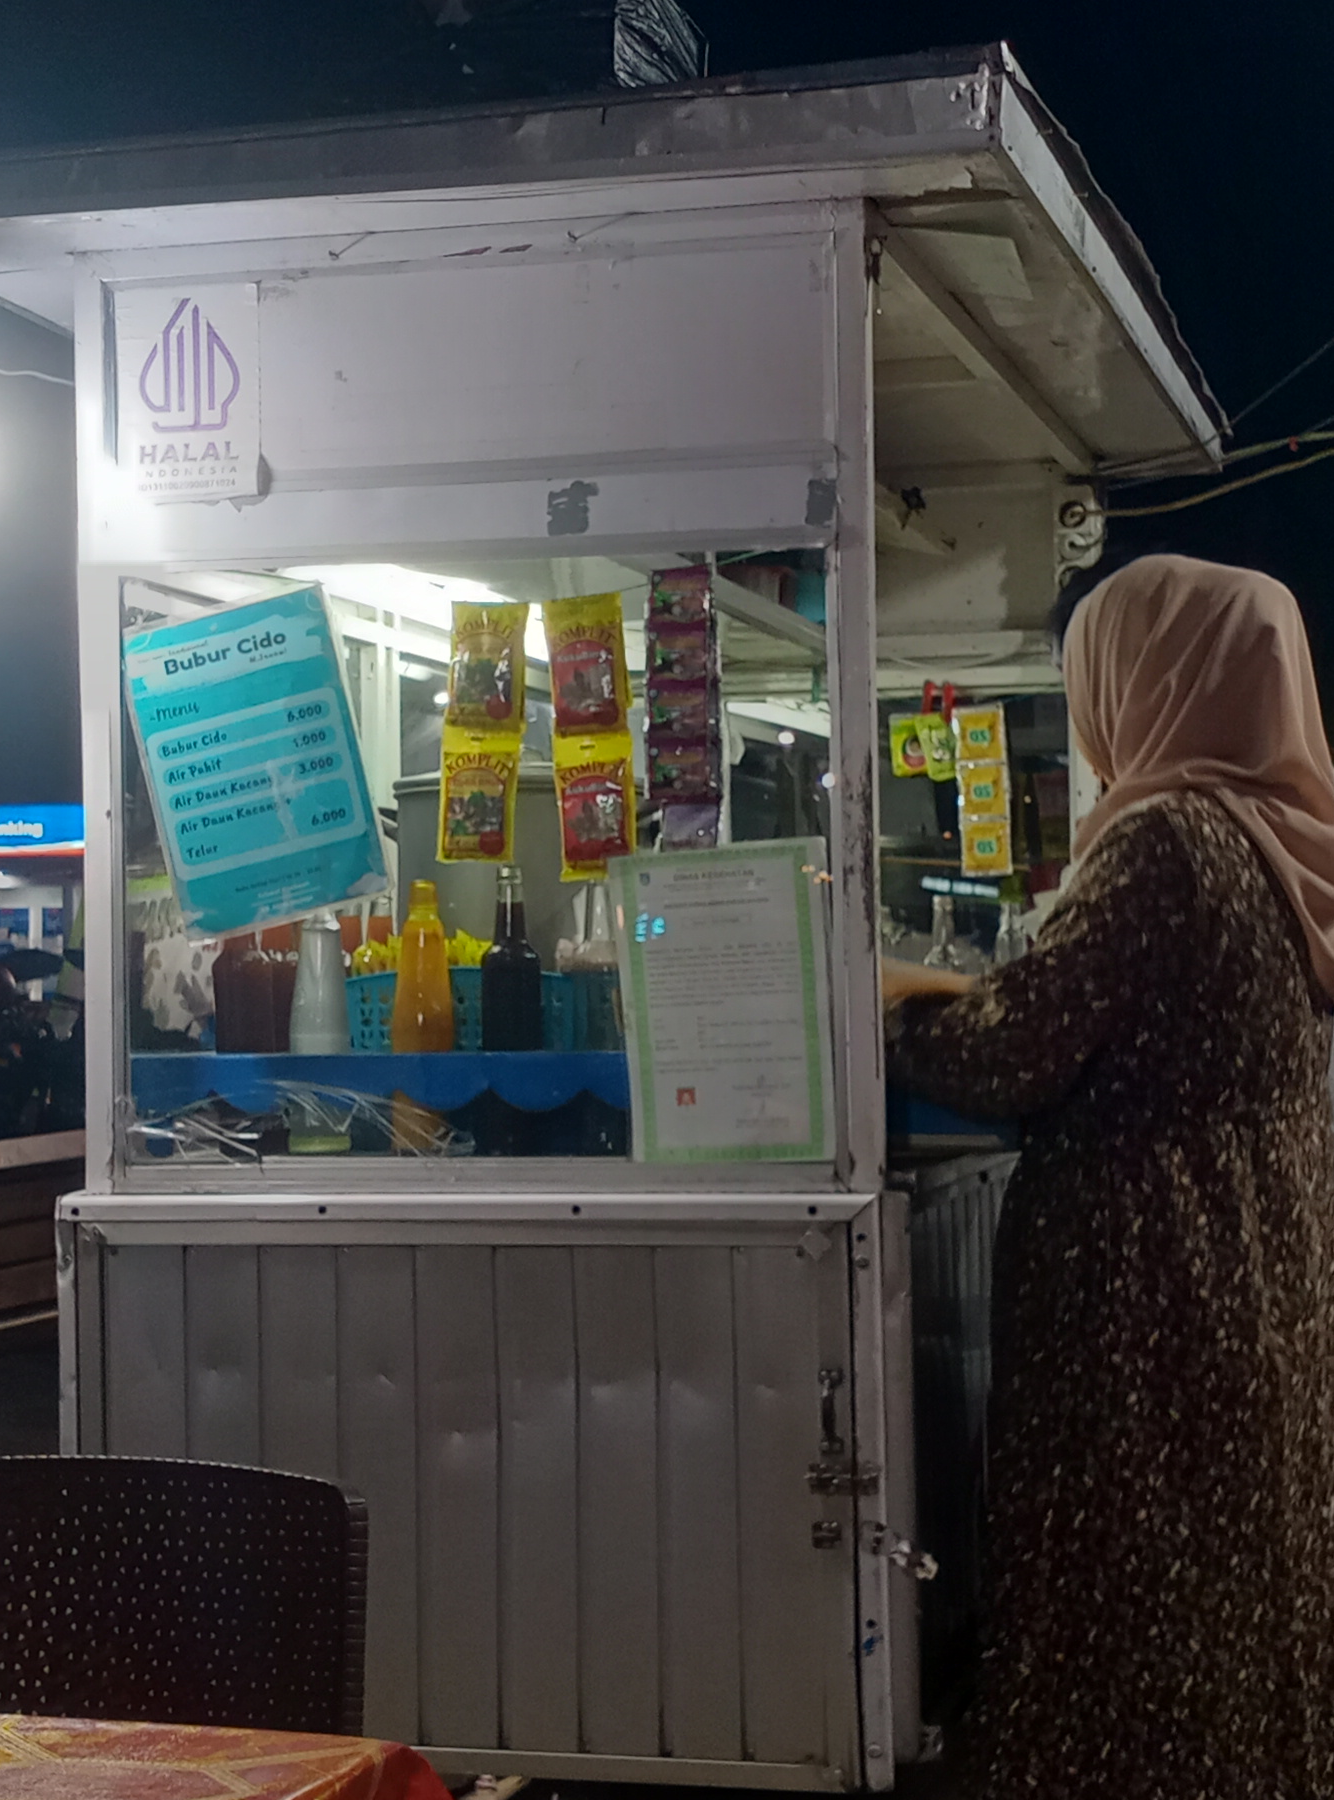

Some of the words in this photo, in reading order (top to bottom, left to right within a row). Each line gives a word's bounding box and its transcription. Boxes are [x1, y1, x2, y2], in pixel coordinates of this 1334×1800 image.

[139, 440, 239, 465] HALAL
[143, 466, 238, 478] NDONESIA
[164, 647, 231, 675] Bubur
[237, 631, 286, 654] Cido
[162, 739, 198, 758] Bubur
[201, 731, 228, 750] Cido
[167, 769, 186, 784] Air
[188, 759, 223, 778] Pahit
[445, 752, 510, 777] KOMPLIT
[560, 759, 625, 785] KOMPL
[174, 795, 193, 810] Air
[196, 787, 227, 805] Daun
[298, 756, 334, 775] 3.000
[180, 820, 199, 835] Air
[201, 812, 234, 830] Daun
[236, 802, 277, 822] Kacan
[186, 844, 219, 861] Telur
